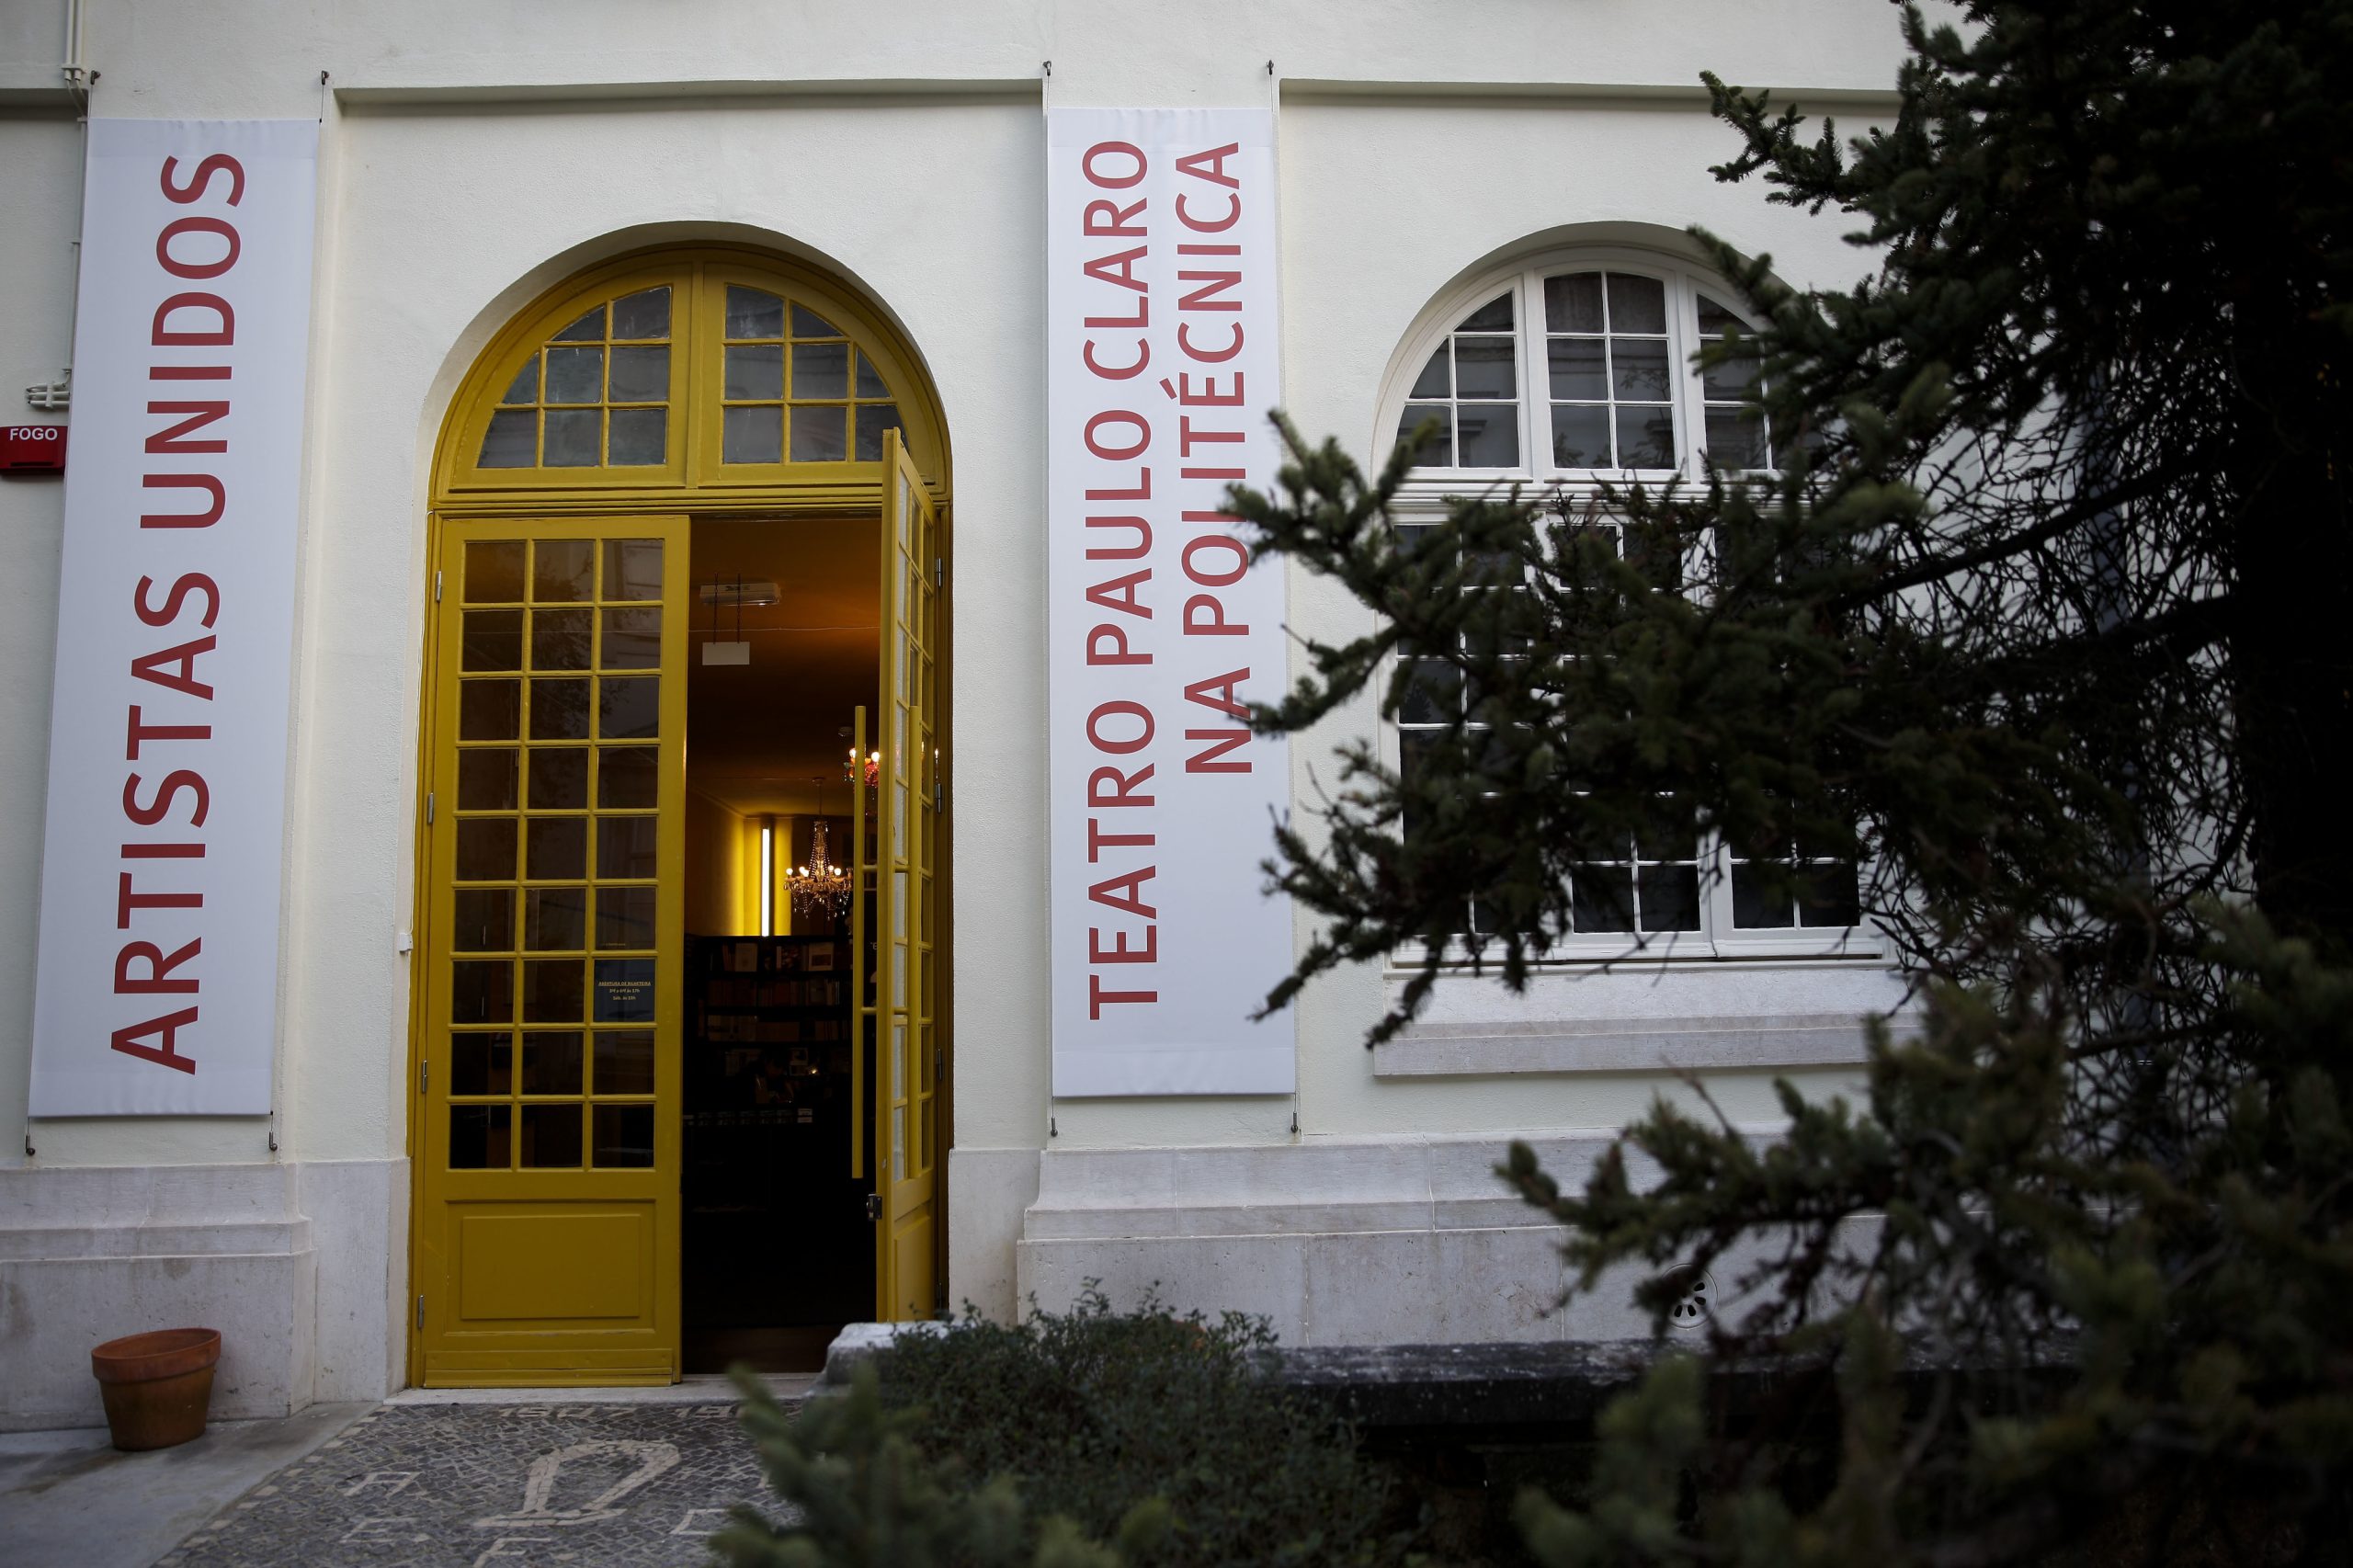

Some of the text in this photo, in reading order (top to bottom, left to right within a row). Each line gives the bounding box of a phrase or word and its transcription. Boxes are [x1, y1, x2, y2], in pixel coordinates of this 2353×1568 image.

[9, 427, 58, 441] FOGO
[111, 153, 245, 1075] ARTISTAS UNIDOS
[1082, 141, 1158, 1020] TEATRO PAULO CLARO
[1160, 142, 1252, 773] NA POLITÉCNICA
